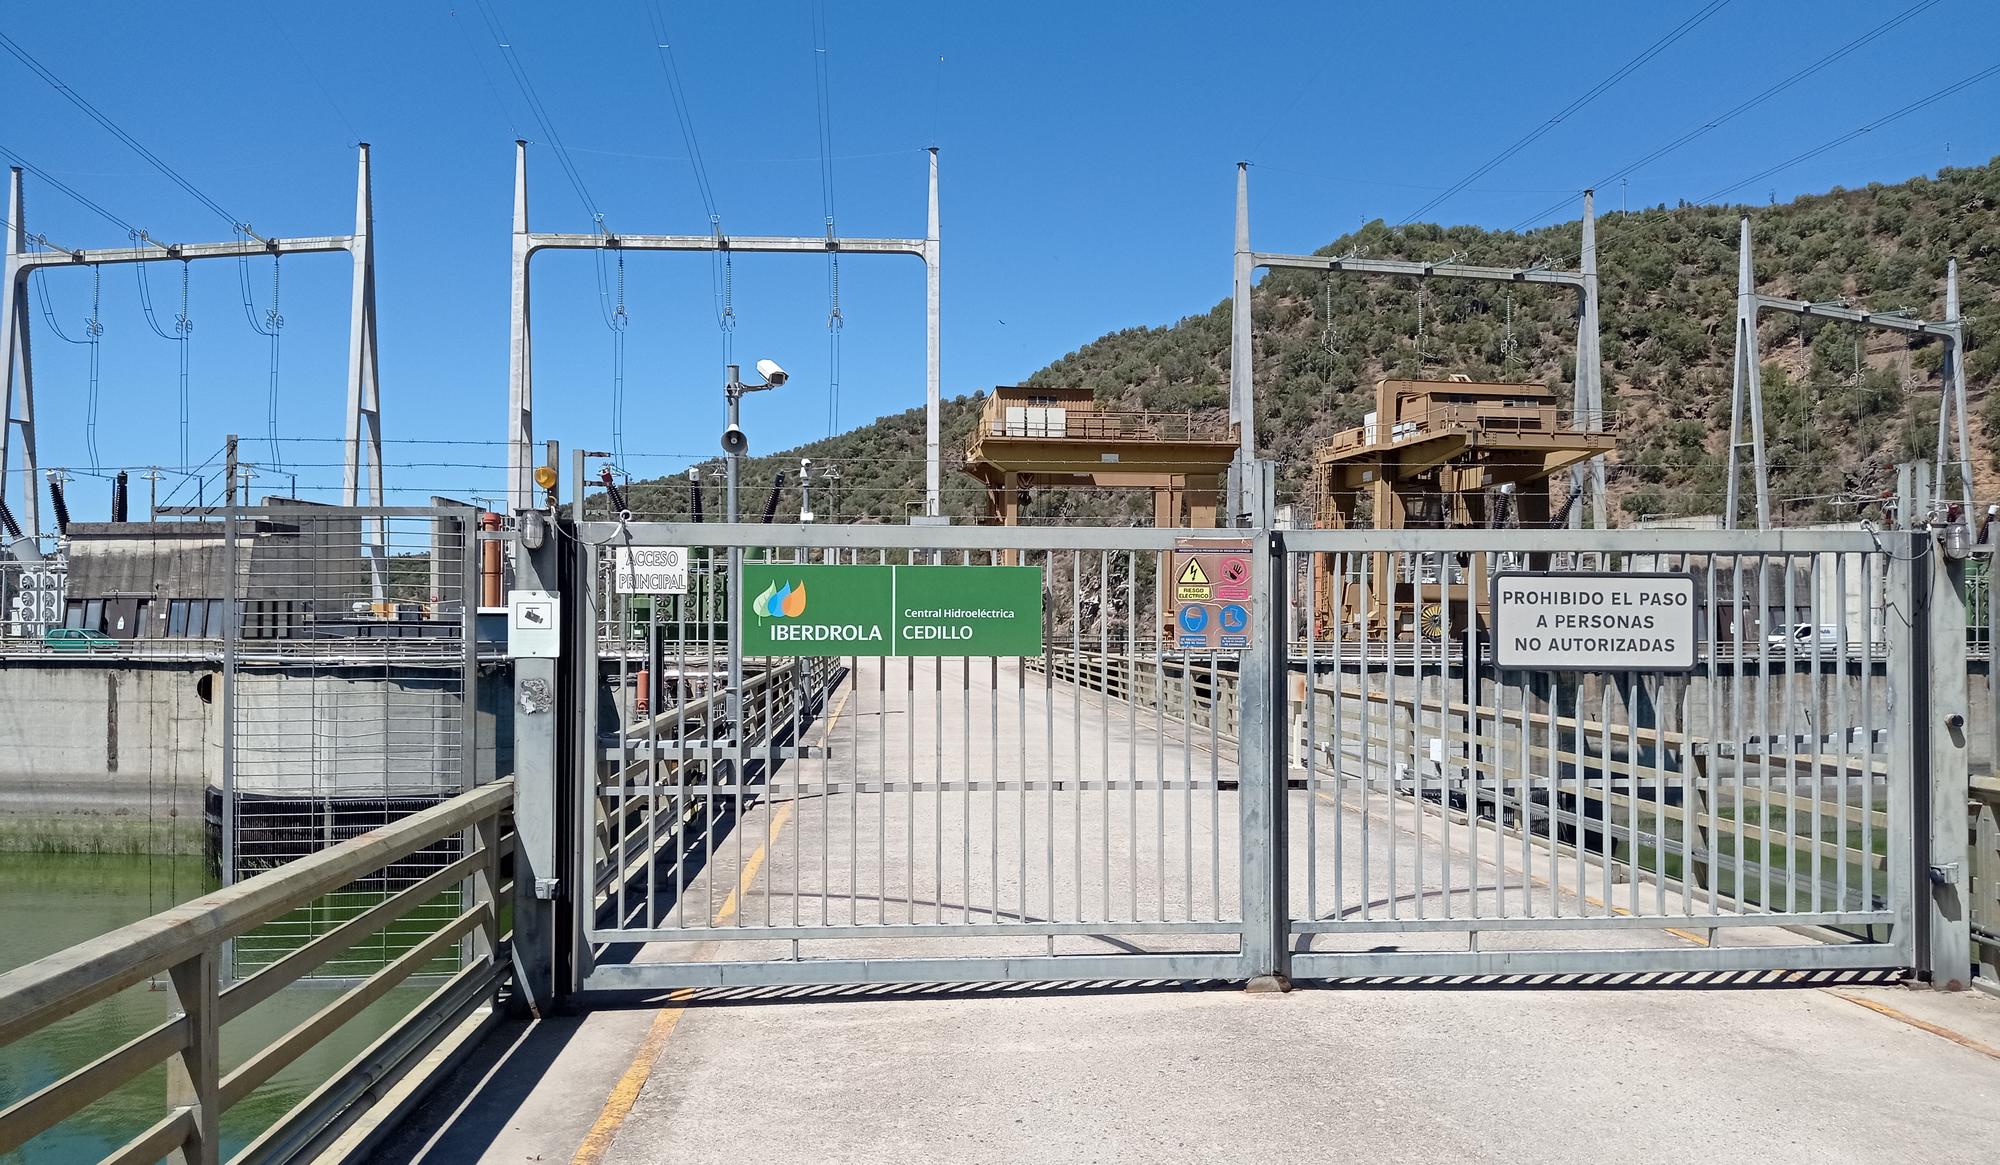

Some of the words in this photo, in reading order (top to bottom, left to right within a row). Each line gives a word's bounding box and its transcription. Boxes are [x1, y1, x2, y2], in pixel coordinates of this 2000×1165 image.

[625, 550, 679, 567] ACCESO
[619, 573, 686, 590] PRINCIPAL
[1503, 591, 1604, 605] PROHIBIDO
[1612, 592, 1632, 605] EL
[1639, 592, 1688, 606] PASO
[904, 608, 942, 618] Central
[944, 608, 1015, 618] Hidroeléctrica
[1536, 614, 1548, 628] A
[1555, 614, 1655, 629] PERSONAS
[770, 624, 883, 641] IBERDROLA
[902, 625, 973, 640] CEDILLO
[1515, 637, 1541, 651] NO
[1549, 638, 1675, 652] AUTORIZADAS
